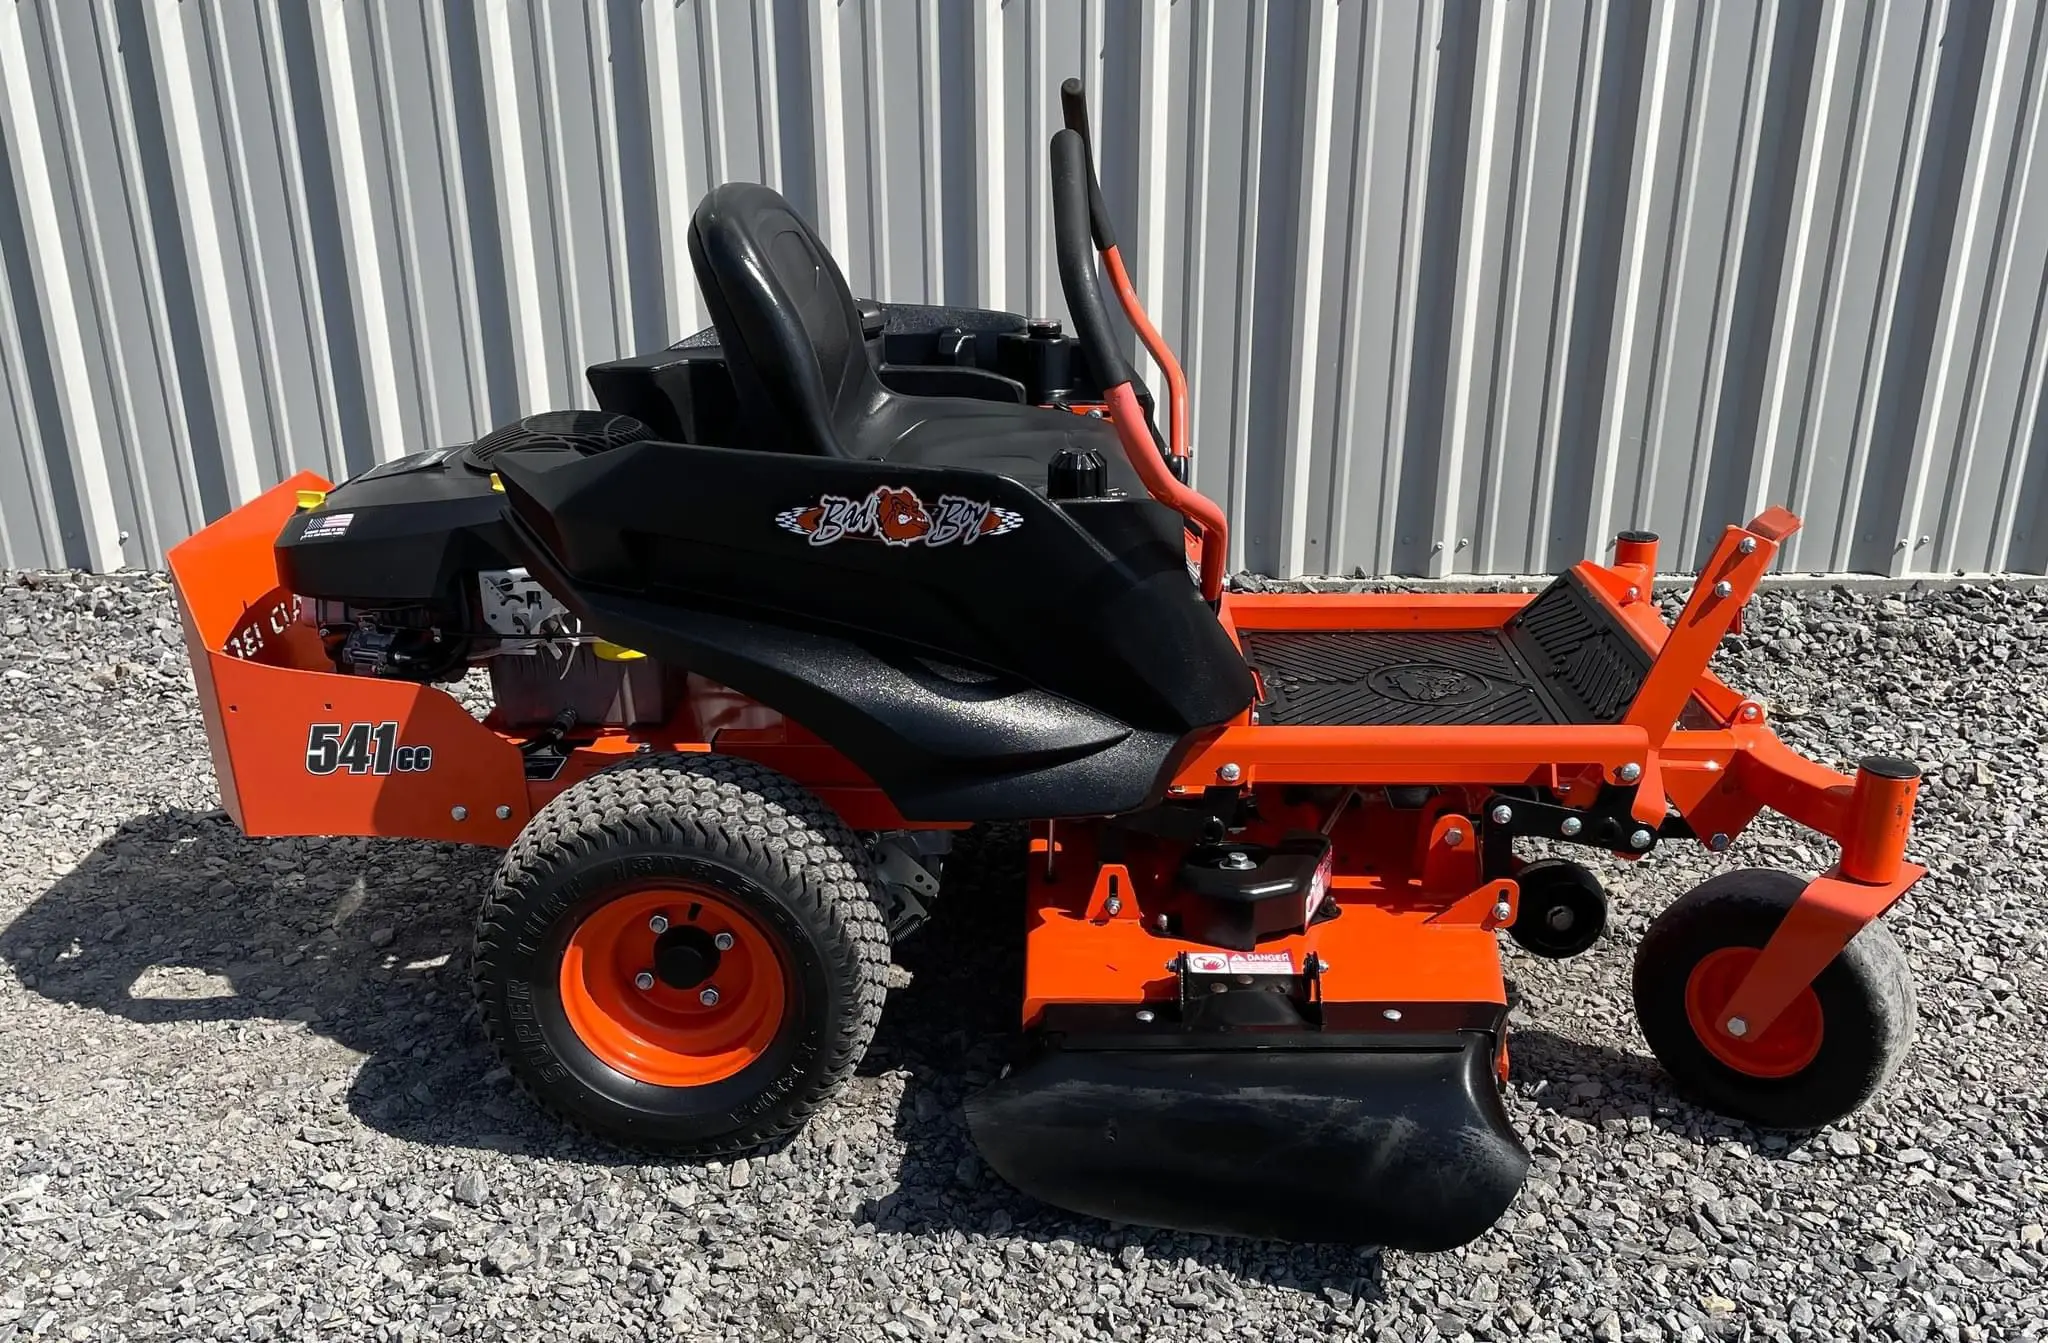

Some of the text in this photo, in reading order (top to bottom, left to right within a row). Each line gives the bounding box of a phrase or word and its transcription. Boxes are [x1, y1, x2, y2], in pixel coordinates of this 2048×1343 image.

[808, 494, 990, 546] Bad Boy
[305, 721, 432, 776] 541cc
[508, 876, 584, 1085] SUPER TURF
[1247, 952, 1290, 962] DANGER
